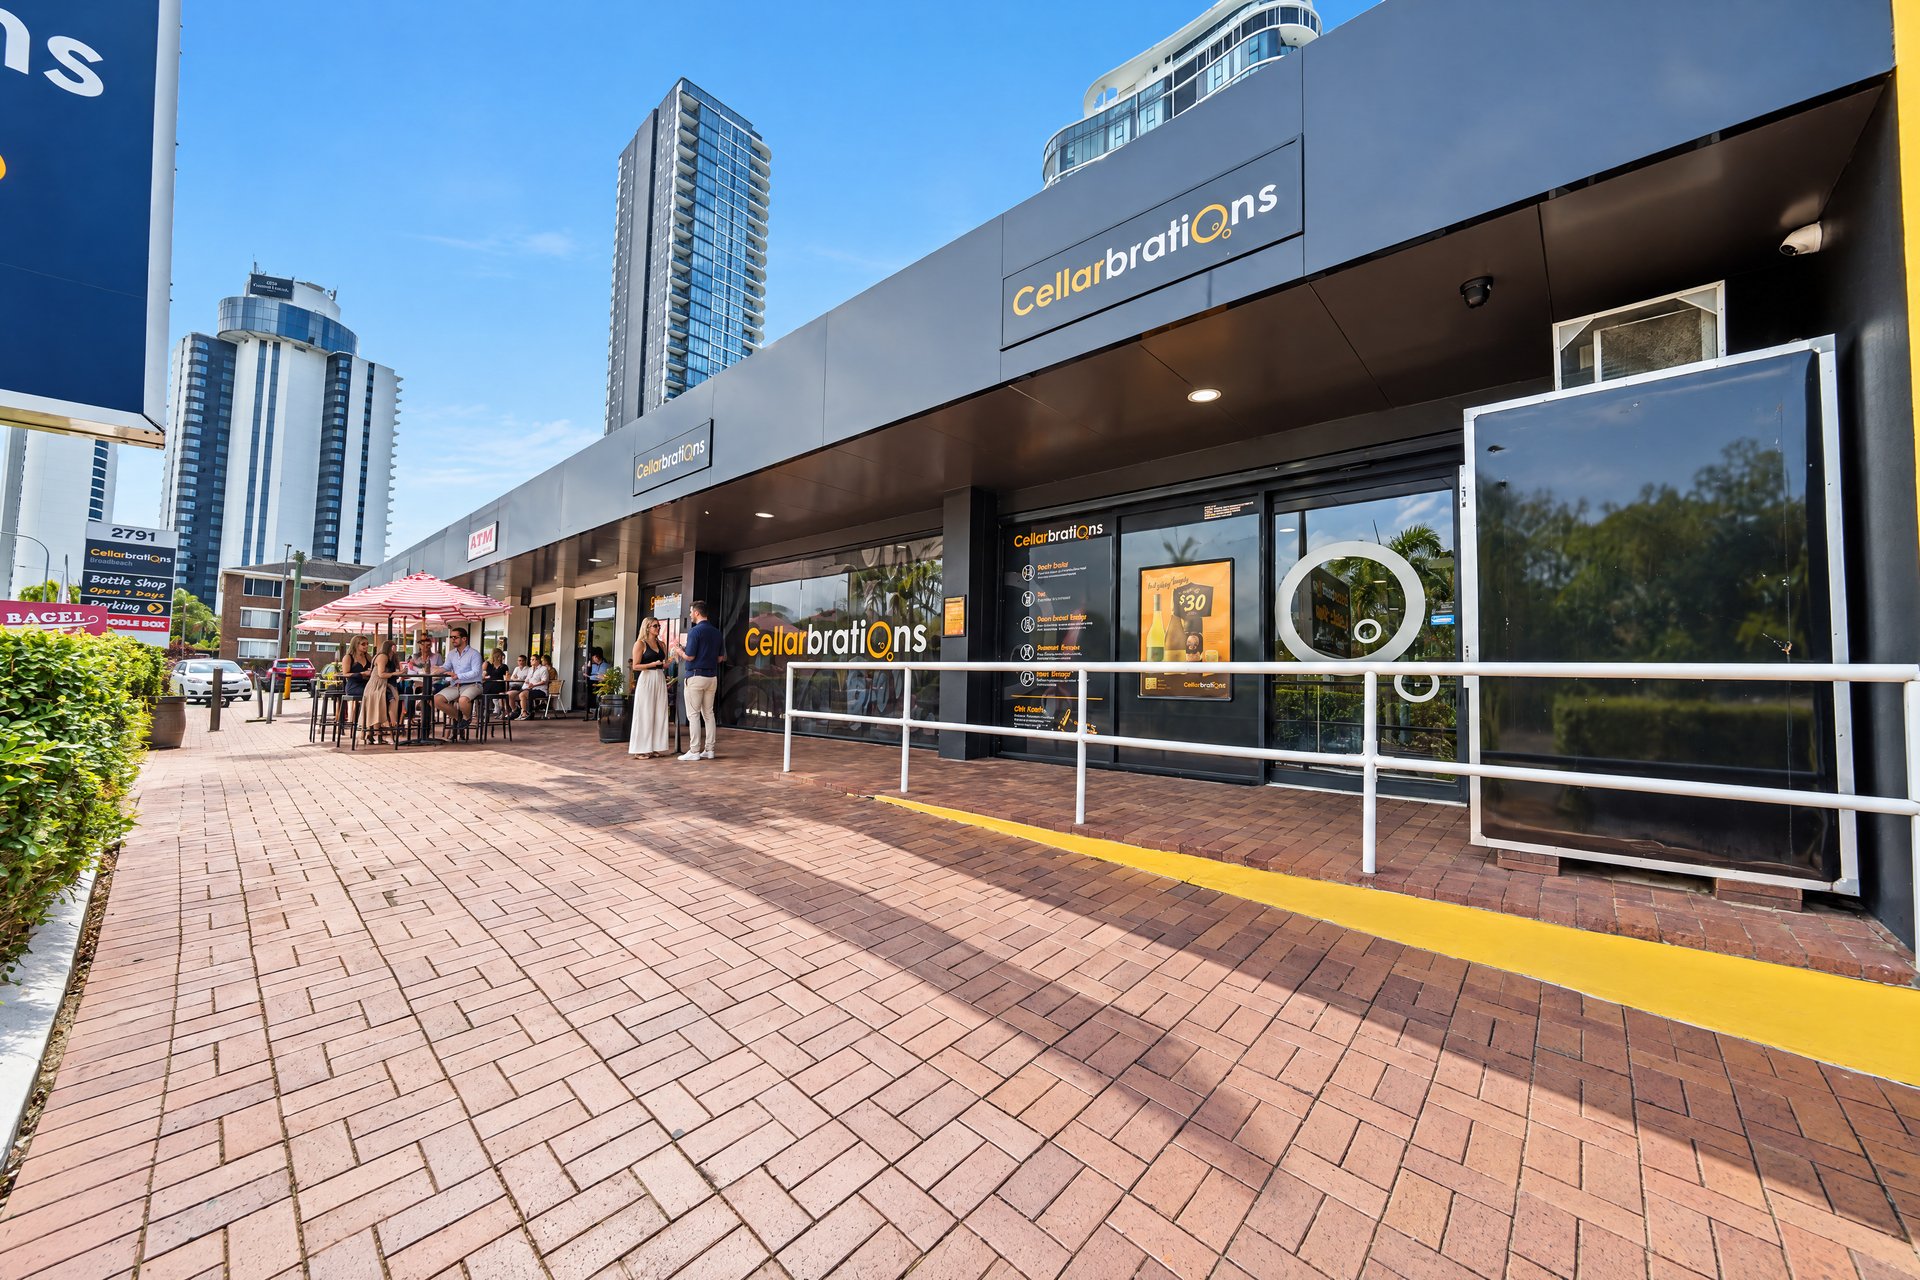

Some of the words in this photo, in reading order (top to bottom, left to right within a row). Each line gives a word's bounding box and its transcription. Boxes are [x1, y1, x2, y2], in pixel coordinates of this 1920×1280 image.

[111, 527, 156, 542] 2791
[470, 527, 494, 550] ATM
[89, 557, 133, 567] Broadbeach
[90, 575, 131, 586] Bottle
[135, 579, 166, 591] Shop
[89, 587, 121, 596] Open
[135, 590, 165, 599] Days
[1179, 593, 1206, 612] $30
[6, 611, 85, 624] BAGEL
[141, 620, 166, 629] BOX
